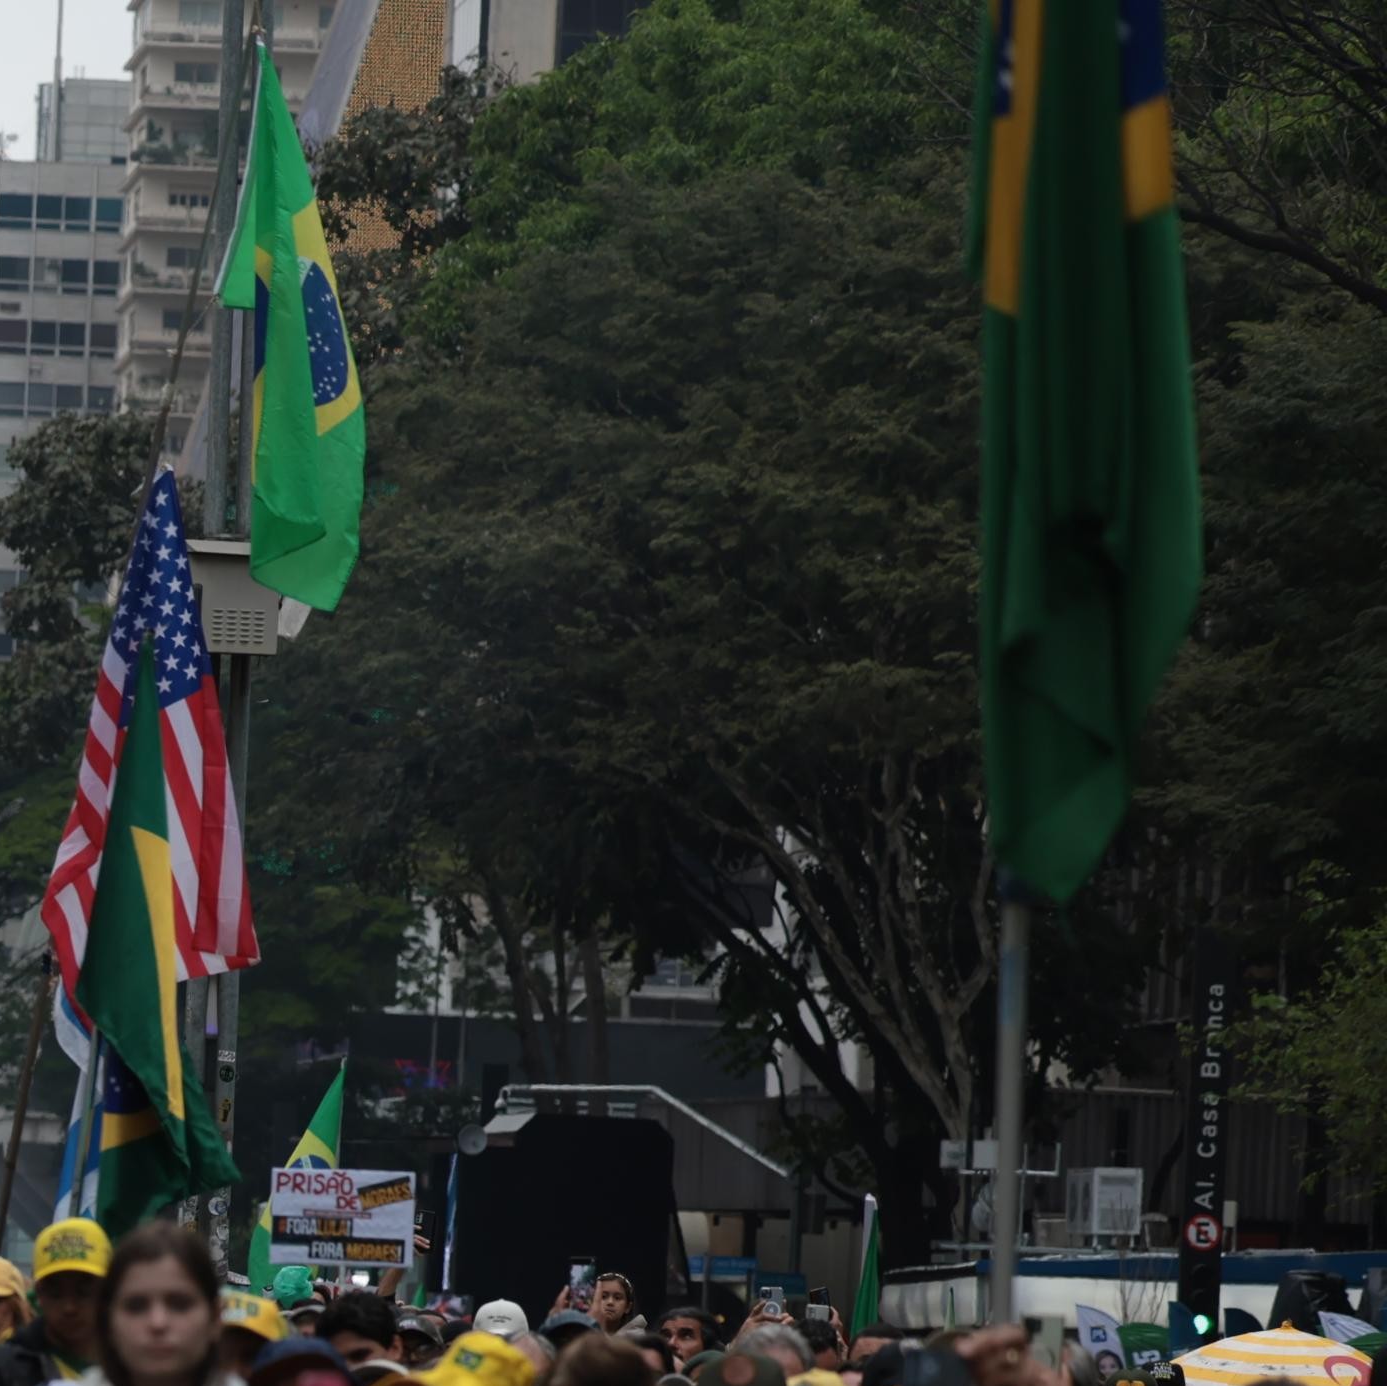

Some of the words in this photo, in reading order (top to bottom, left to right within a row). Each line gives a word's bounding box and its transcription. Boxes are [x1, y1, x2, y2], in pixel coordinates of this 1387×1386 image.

[1199, 983, 1225, 1079] Brnca
[1195, 1090, 1220, 1159] Casa
[275, 1171, 354, 1196] PRISÃO
[1194, 1171, 1216, 1211] Al.
[336, 1195, 359, 1210] DE
[310, 1240, 344, 1259] FORA
